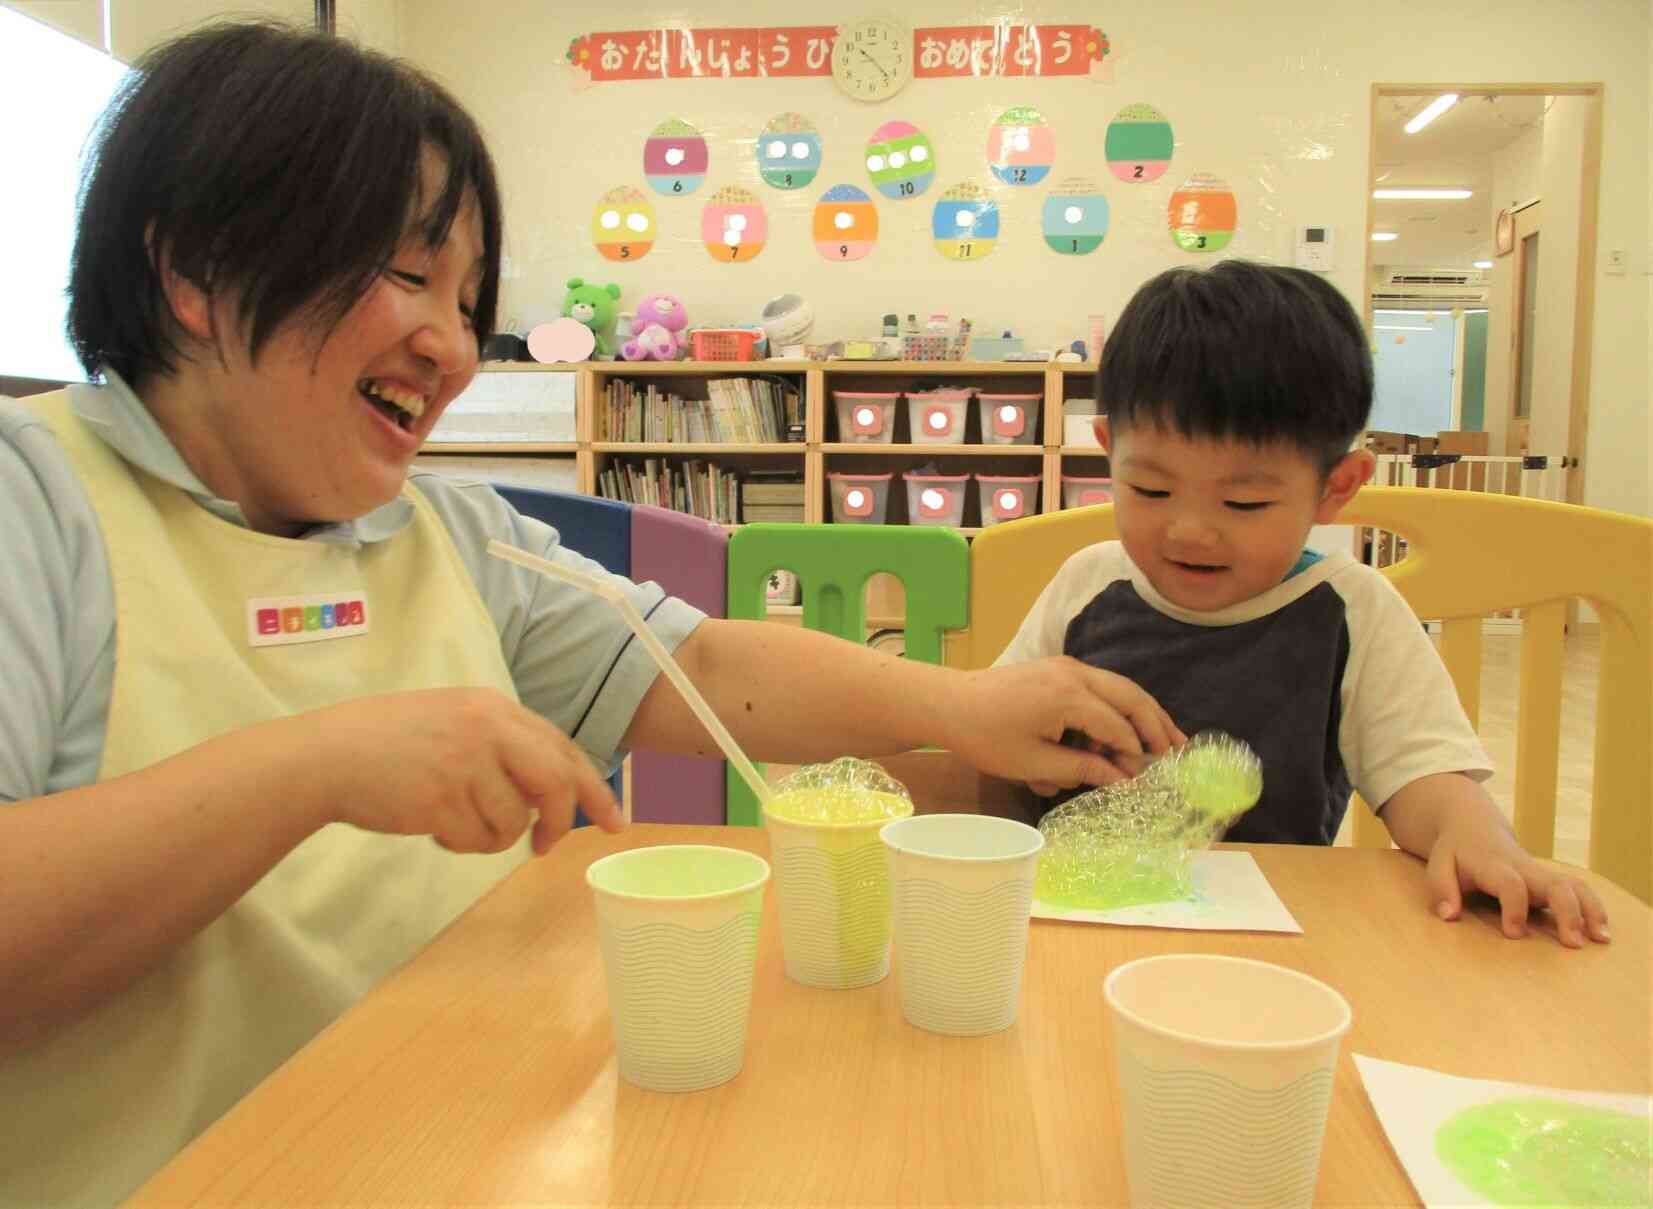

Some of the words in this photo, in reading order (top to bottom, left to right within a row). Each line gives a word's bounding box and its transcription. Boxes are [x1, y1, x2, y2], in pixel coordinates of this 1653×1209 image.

[920, 31, 1073, 70] おめでとう
[1013, 169, 1026, 182] 12
[1134, 165, 1144, 178] 2
[673, 179, 683, 192] 6
[784, 174, 793, 186] 8
[900, 181, 914, 196] 10
[1072, 239, 1078, 252] 1
[1197, 236, 1206, 249] 3
[620, 246, 630, 258] 5
[731, 246, 738, 259] 7
[839, 245, 848, 257] 9
[960, 244, 971, 257] 11
